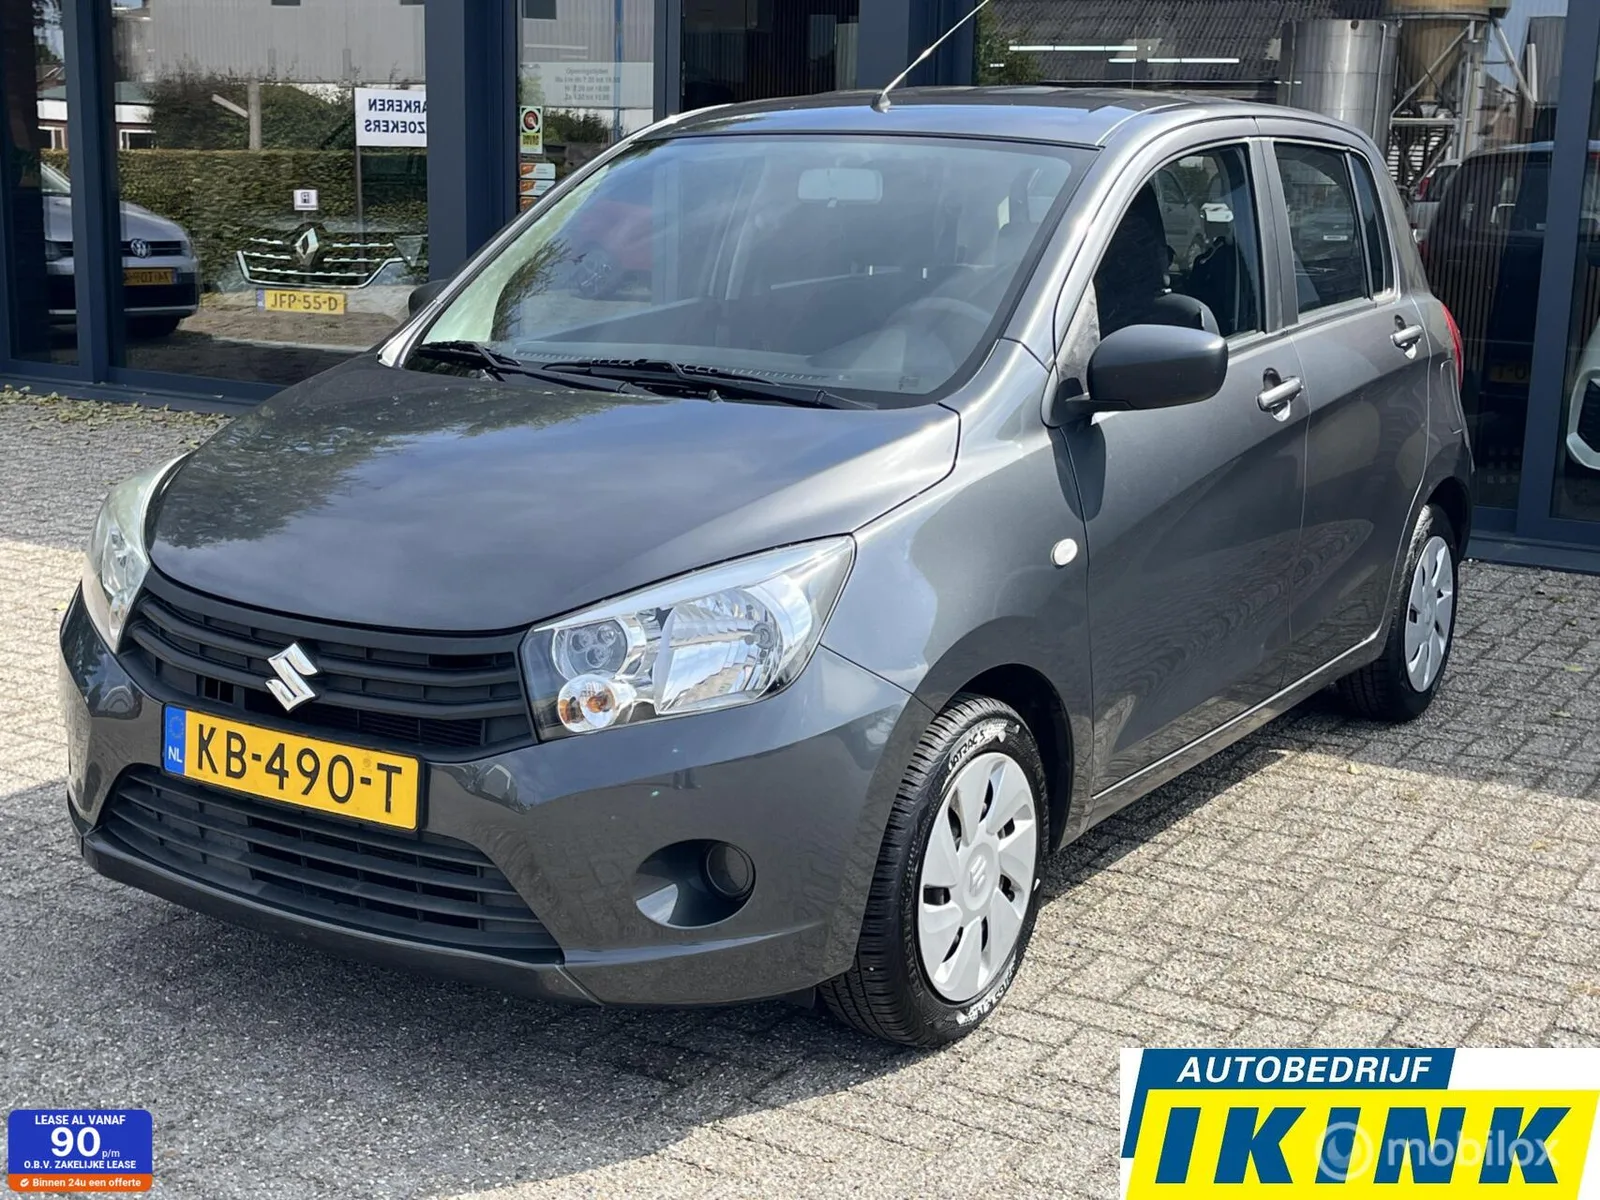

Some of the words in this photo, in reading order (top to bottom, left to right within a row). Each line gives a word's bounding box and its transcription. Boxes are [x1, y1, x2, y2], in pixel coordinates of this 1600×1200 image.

[271, 293, 338, 311] JFP-55-D
[168, 746, 183, 763] NL
[197, 723, 403, 813] KB-490-T
